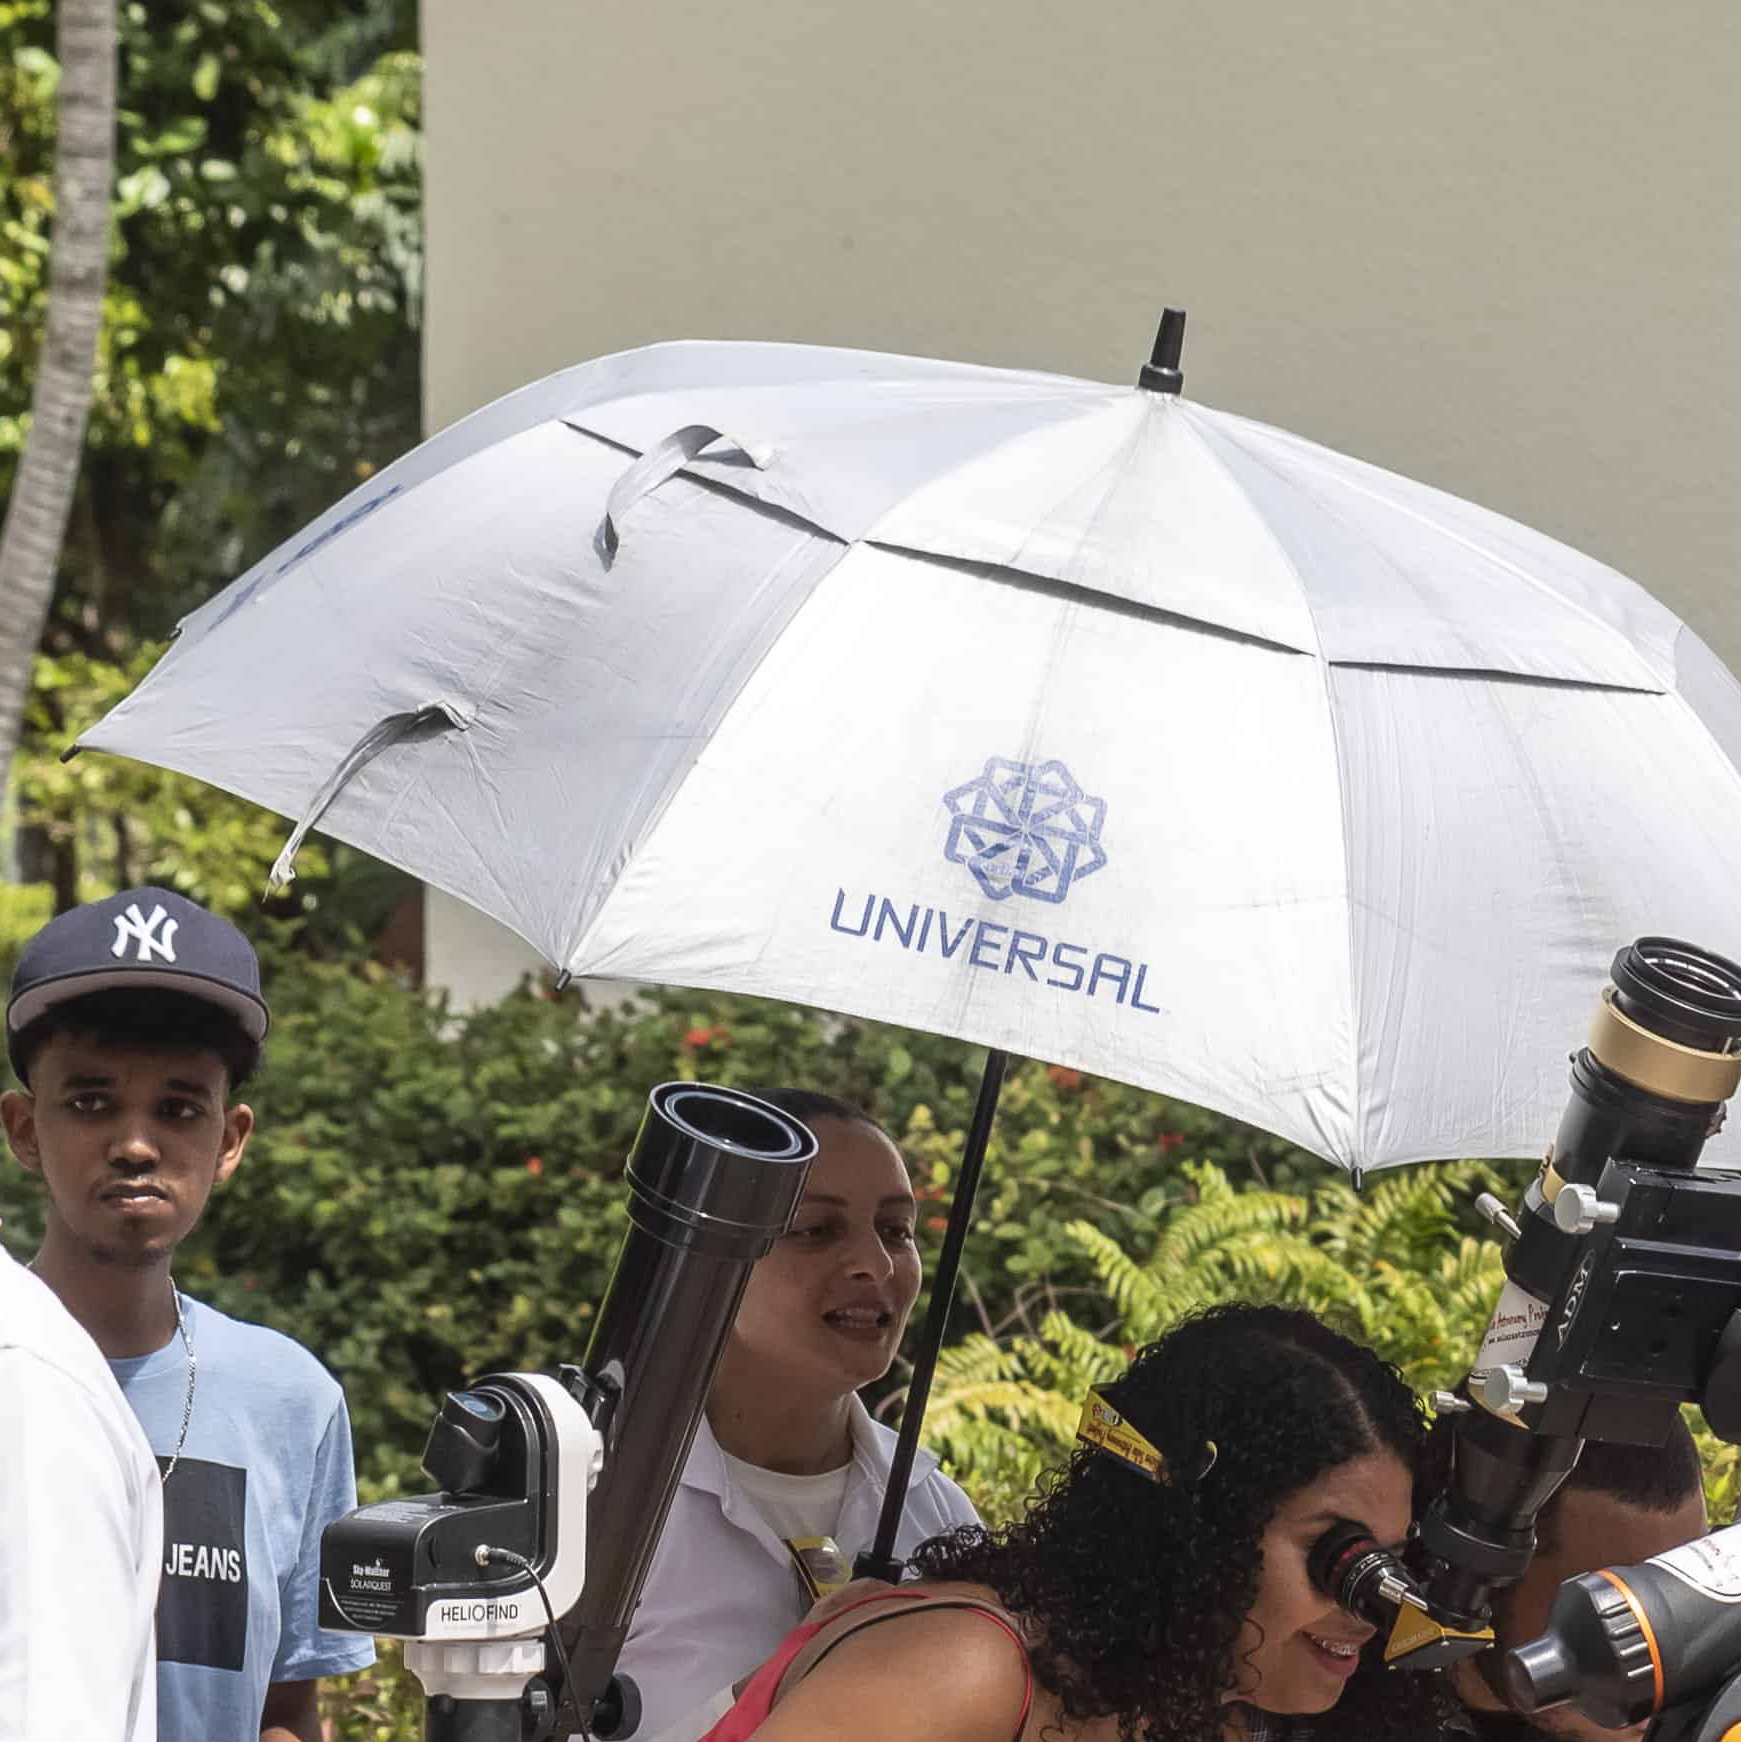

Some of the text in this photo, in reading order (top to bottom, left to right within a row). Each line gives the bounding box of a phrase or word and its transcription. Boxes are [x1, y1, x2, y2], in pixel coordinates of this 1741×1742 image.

[830, 887, 1161, 1015] UNIVERSAL
[165, 1543, 242, 1583] JEANS
[441, 1604, 519, 1622] HELIOFIND
